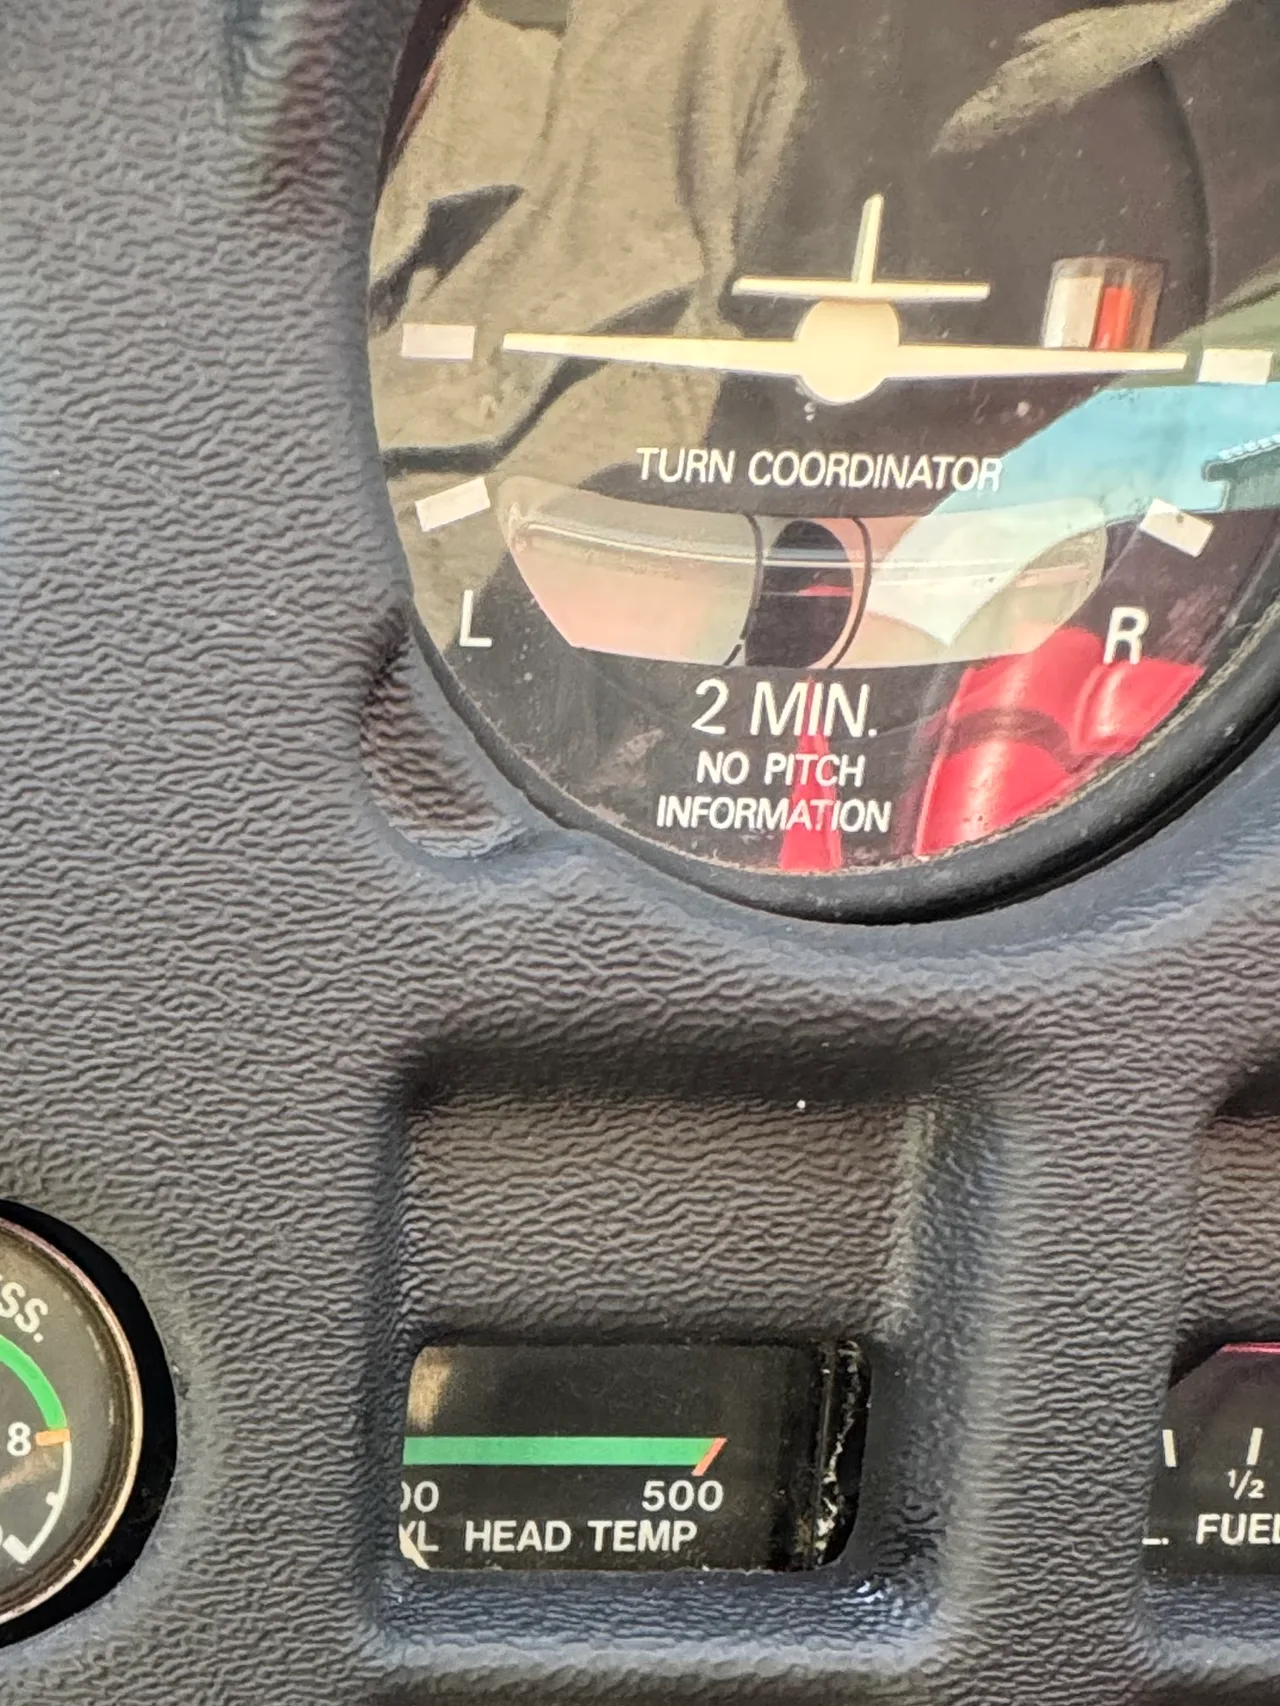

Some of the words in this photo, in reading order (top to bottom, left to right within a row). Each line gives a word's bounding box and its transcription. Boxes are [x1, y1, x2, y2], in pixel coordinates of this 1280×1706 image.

[636, 447, 735, 485] TURN
[748, 449, 1003, 493] COORDINATOR
[459, 589, 493, 648] L
[1103, 606, 1148, 665] R
[691, 678, 729, 737] 2
[750, 681, 878, 738] MIN.
[696, 751, 750, 786] NO
[764, 754, 866, 789] PITCH
[656, 795, 892, 834] INFORMATION
[6, 1421, 32, 1457] 8
[641, 1479, 724, 1513] 500
[464, 1519, 571, 1552] HEAD
[587, 1519, 698, 1553] TEMP
